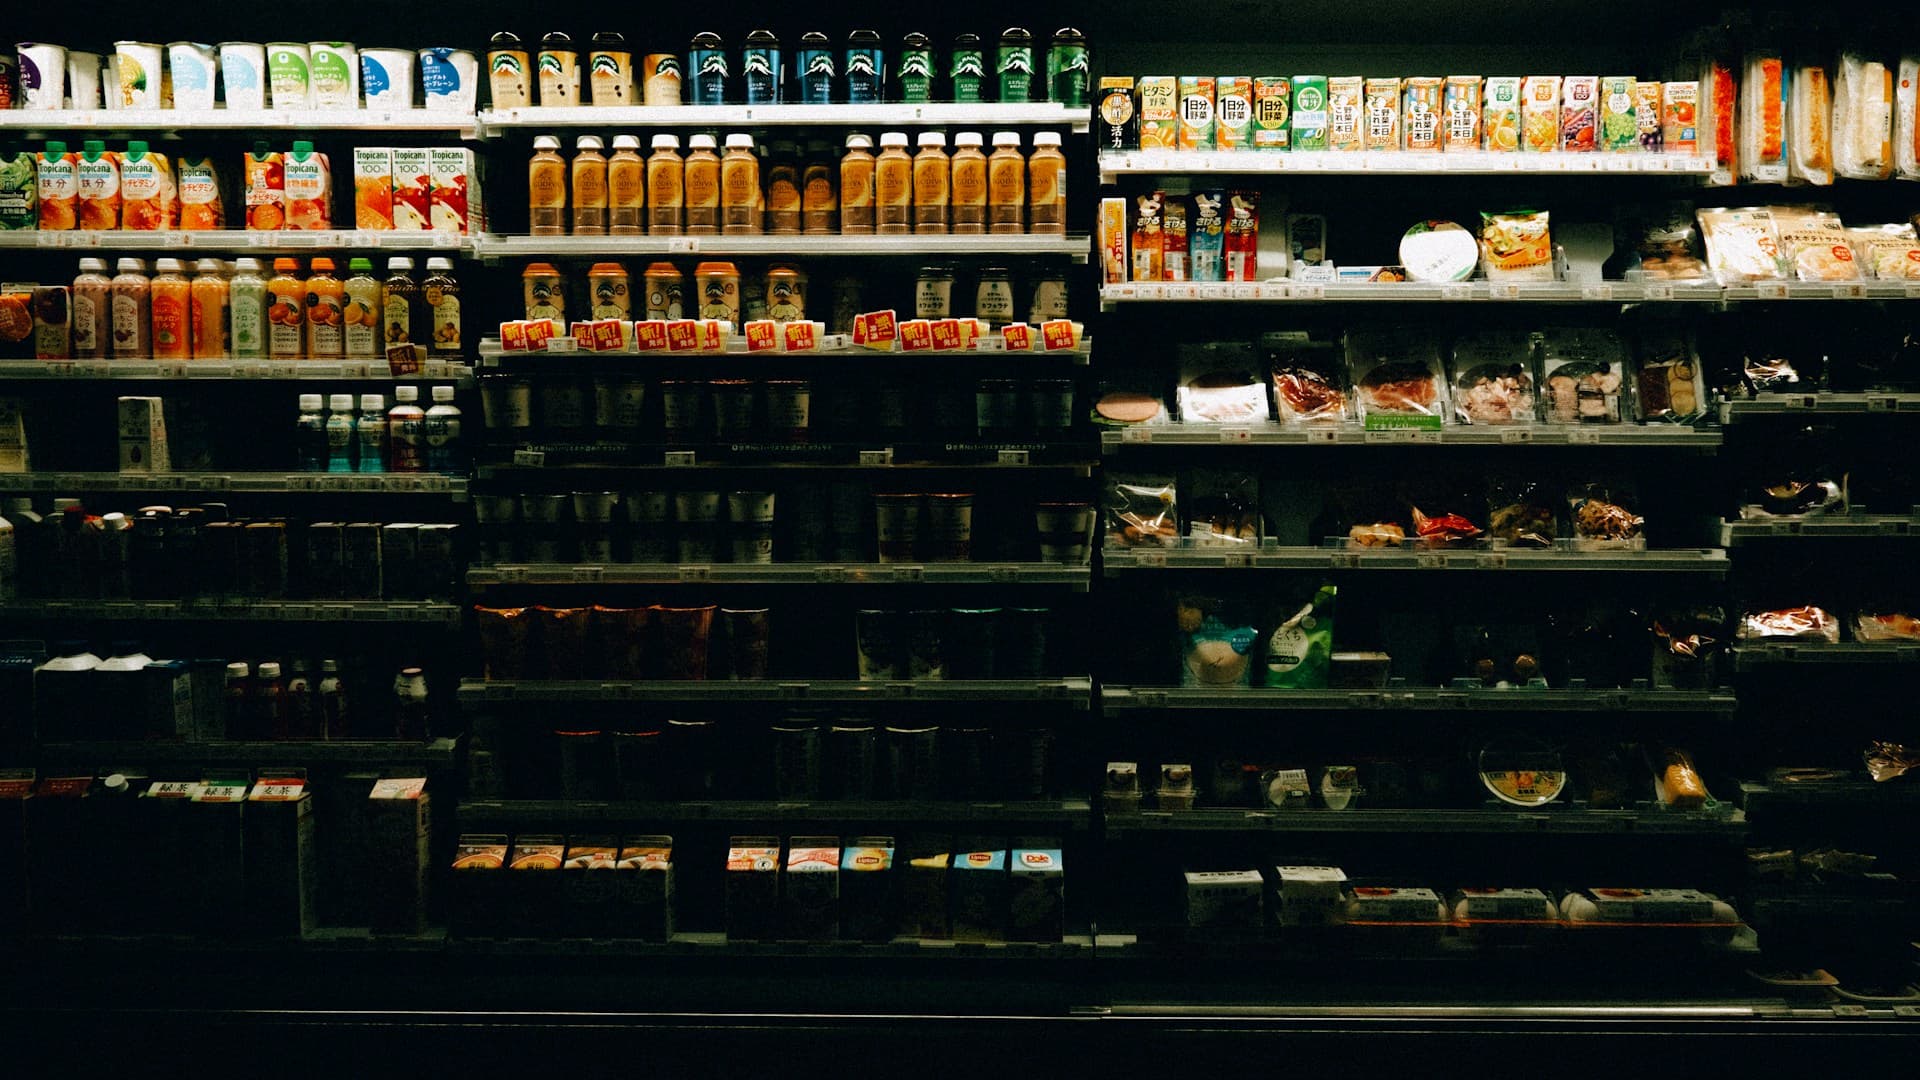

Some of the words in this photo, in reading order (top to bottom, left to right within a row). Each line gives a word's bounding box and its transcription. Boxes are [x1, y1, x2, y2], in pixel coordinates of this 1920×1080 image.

[1143, 86, 1174, 97] ビタミン
[355, 150, 388, 160] Tropicana
[393, 150, 426, 160] Tropicana
[431, 150, 464, 160] Tropicana
[1026, 855, 1049, 863] Dole
